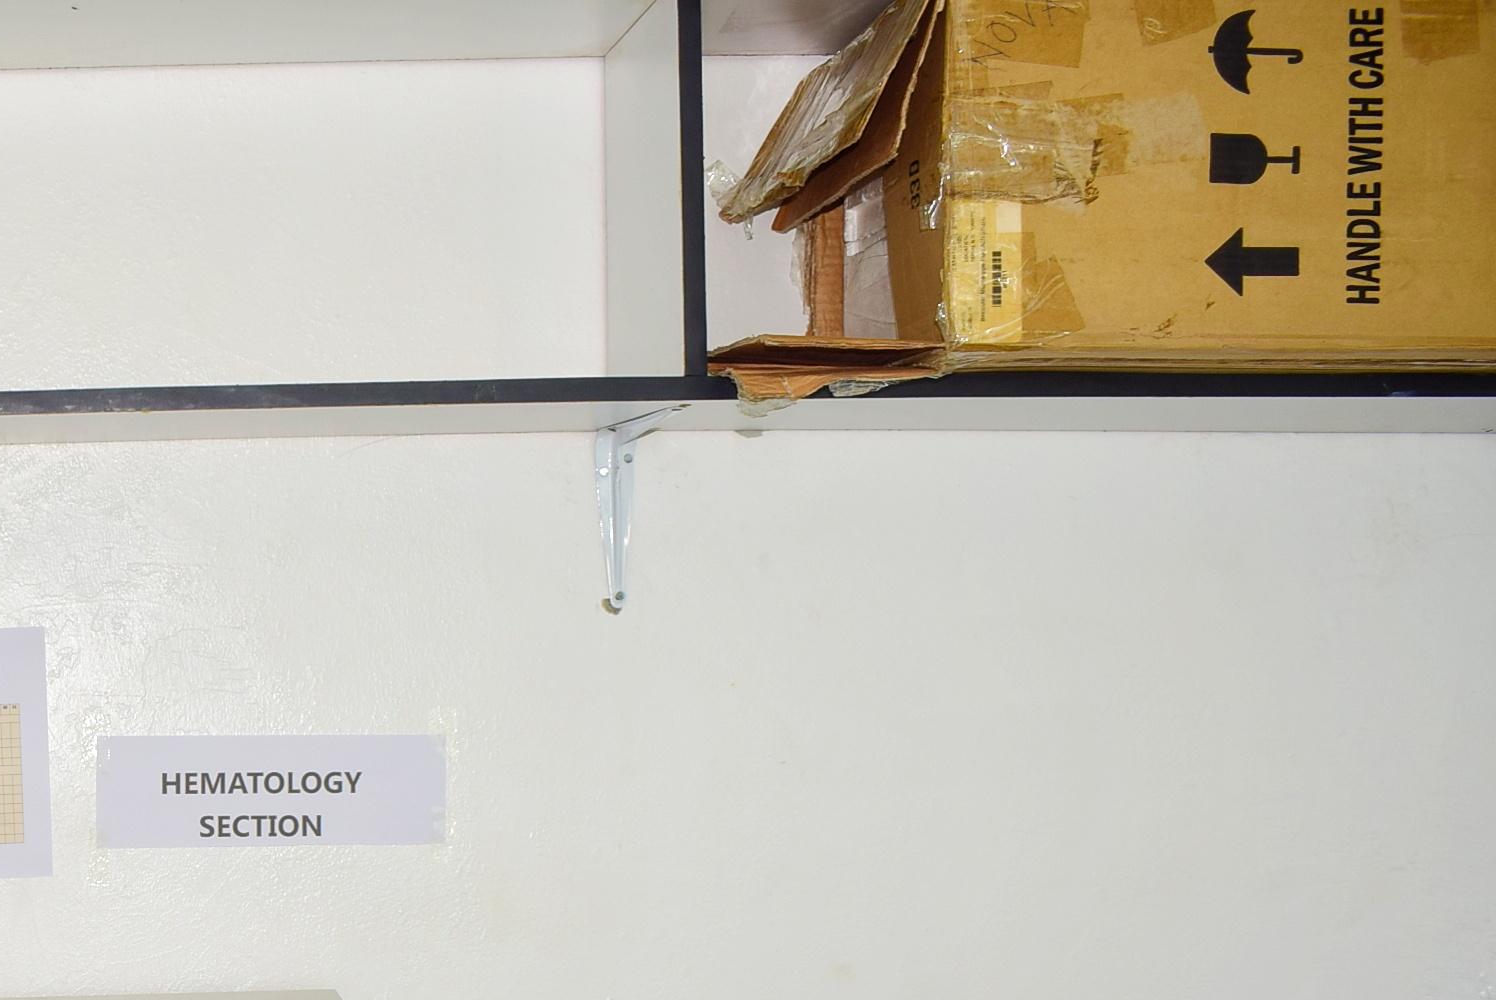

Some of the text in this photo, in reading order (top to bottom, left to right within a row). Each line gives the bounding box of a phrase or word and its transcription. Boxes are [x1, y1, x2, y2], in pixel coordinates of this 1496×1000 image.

[1346, 7, 1384, 304] HANDLE WITH CARE
[161, 772, 362, 794] HEMATOLOGY
[199, 815, 322, 838] SECTION
